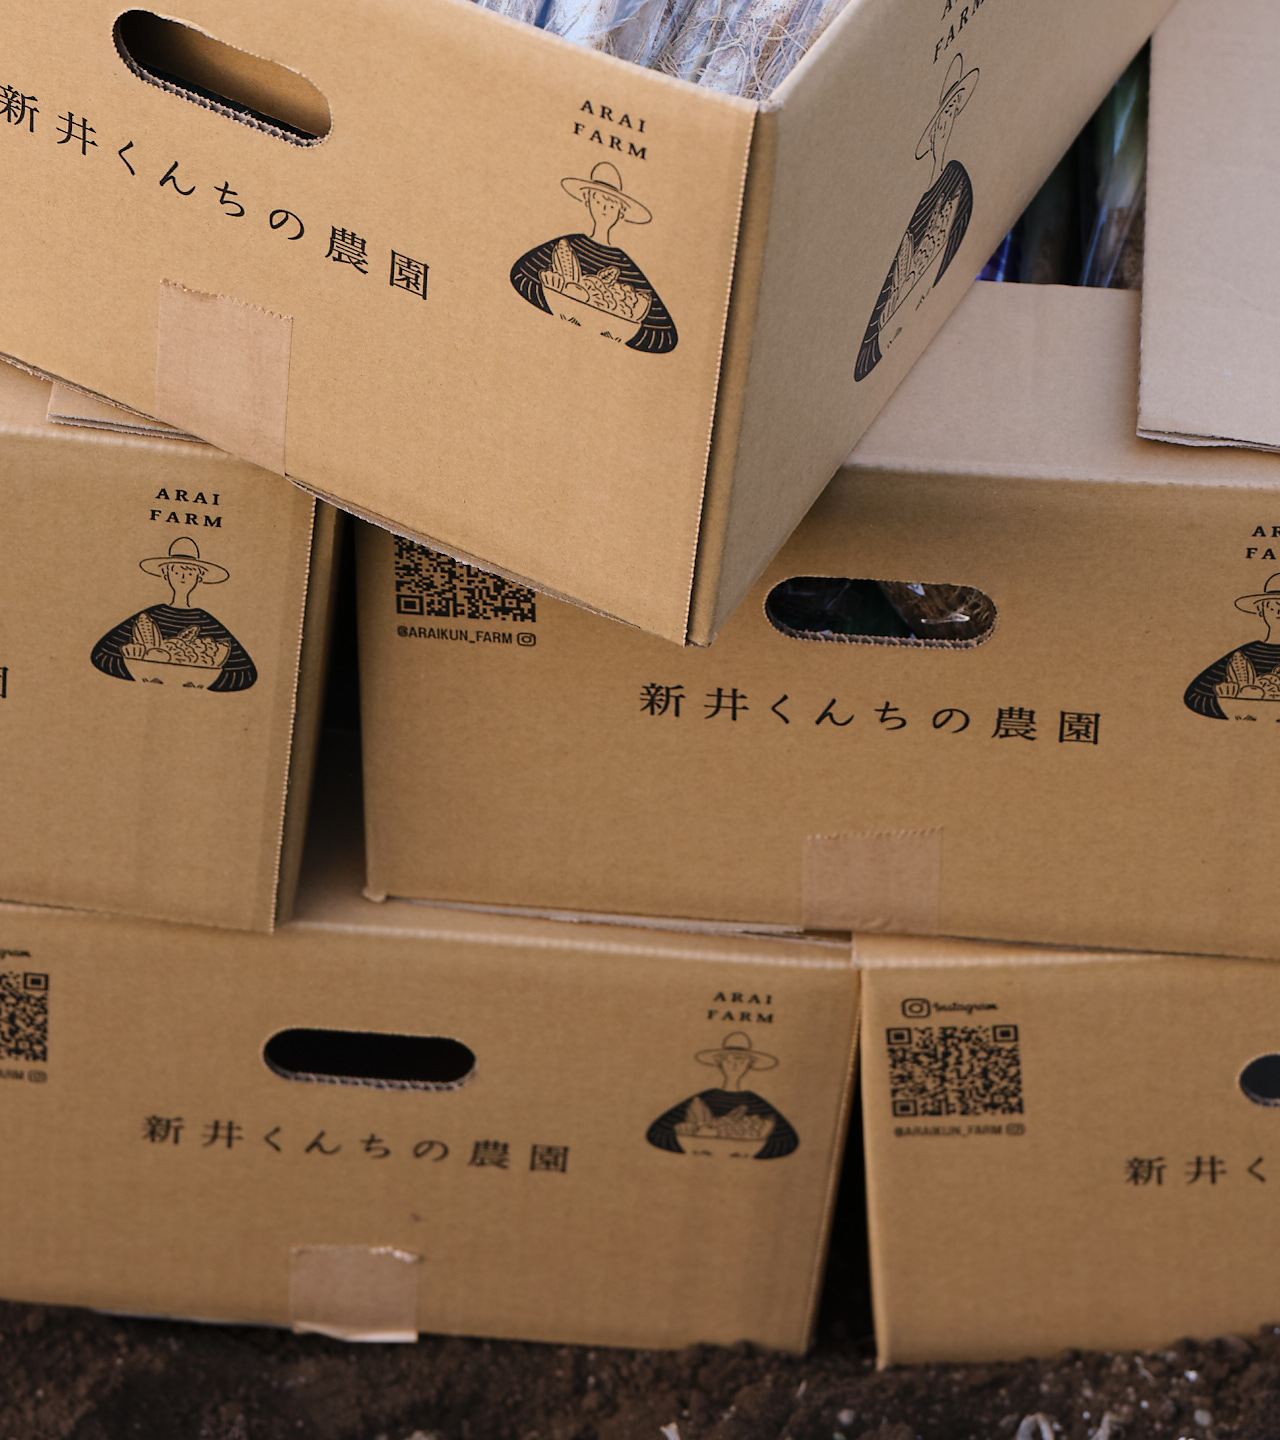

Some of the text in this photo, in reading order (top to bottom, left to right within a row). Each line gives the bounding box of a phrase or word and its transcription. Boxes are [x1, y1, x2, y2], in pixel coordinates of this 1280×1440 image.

[579, 99, 647, 134] ARAI
[573, 120, 648, 160] FARM
[155, 488, 220, 506] ARAI
[150, 508, 222, 529] FARM
[397, 625, 513, 644] @ARAIKUN_FARM
[639, 682, 1102, 746] 新井くんちの農園
[713, 991, 772, 1006] ARAI
[707, 1009, 774, 1024] FARM
[144, 1114, 570, 1174] 新井くんちの農園
